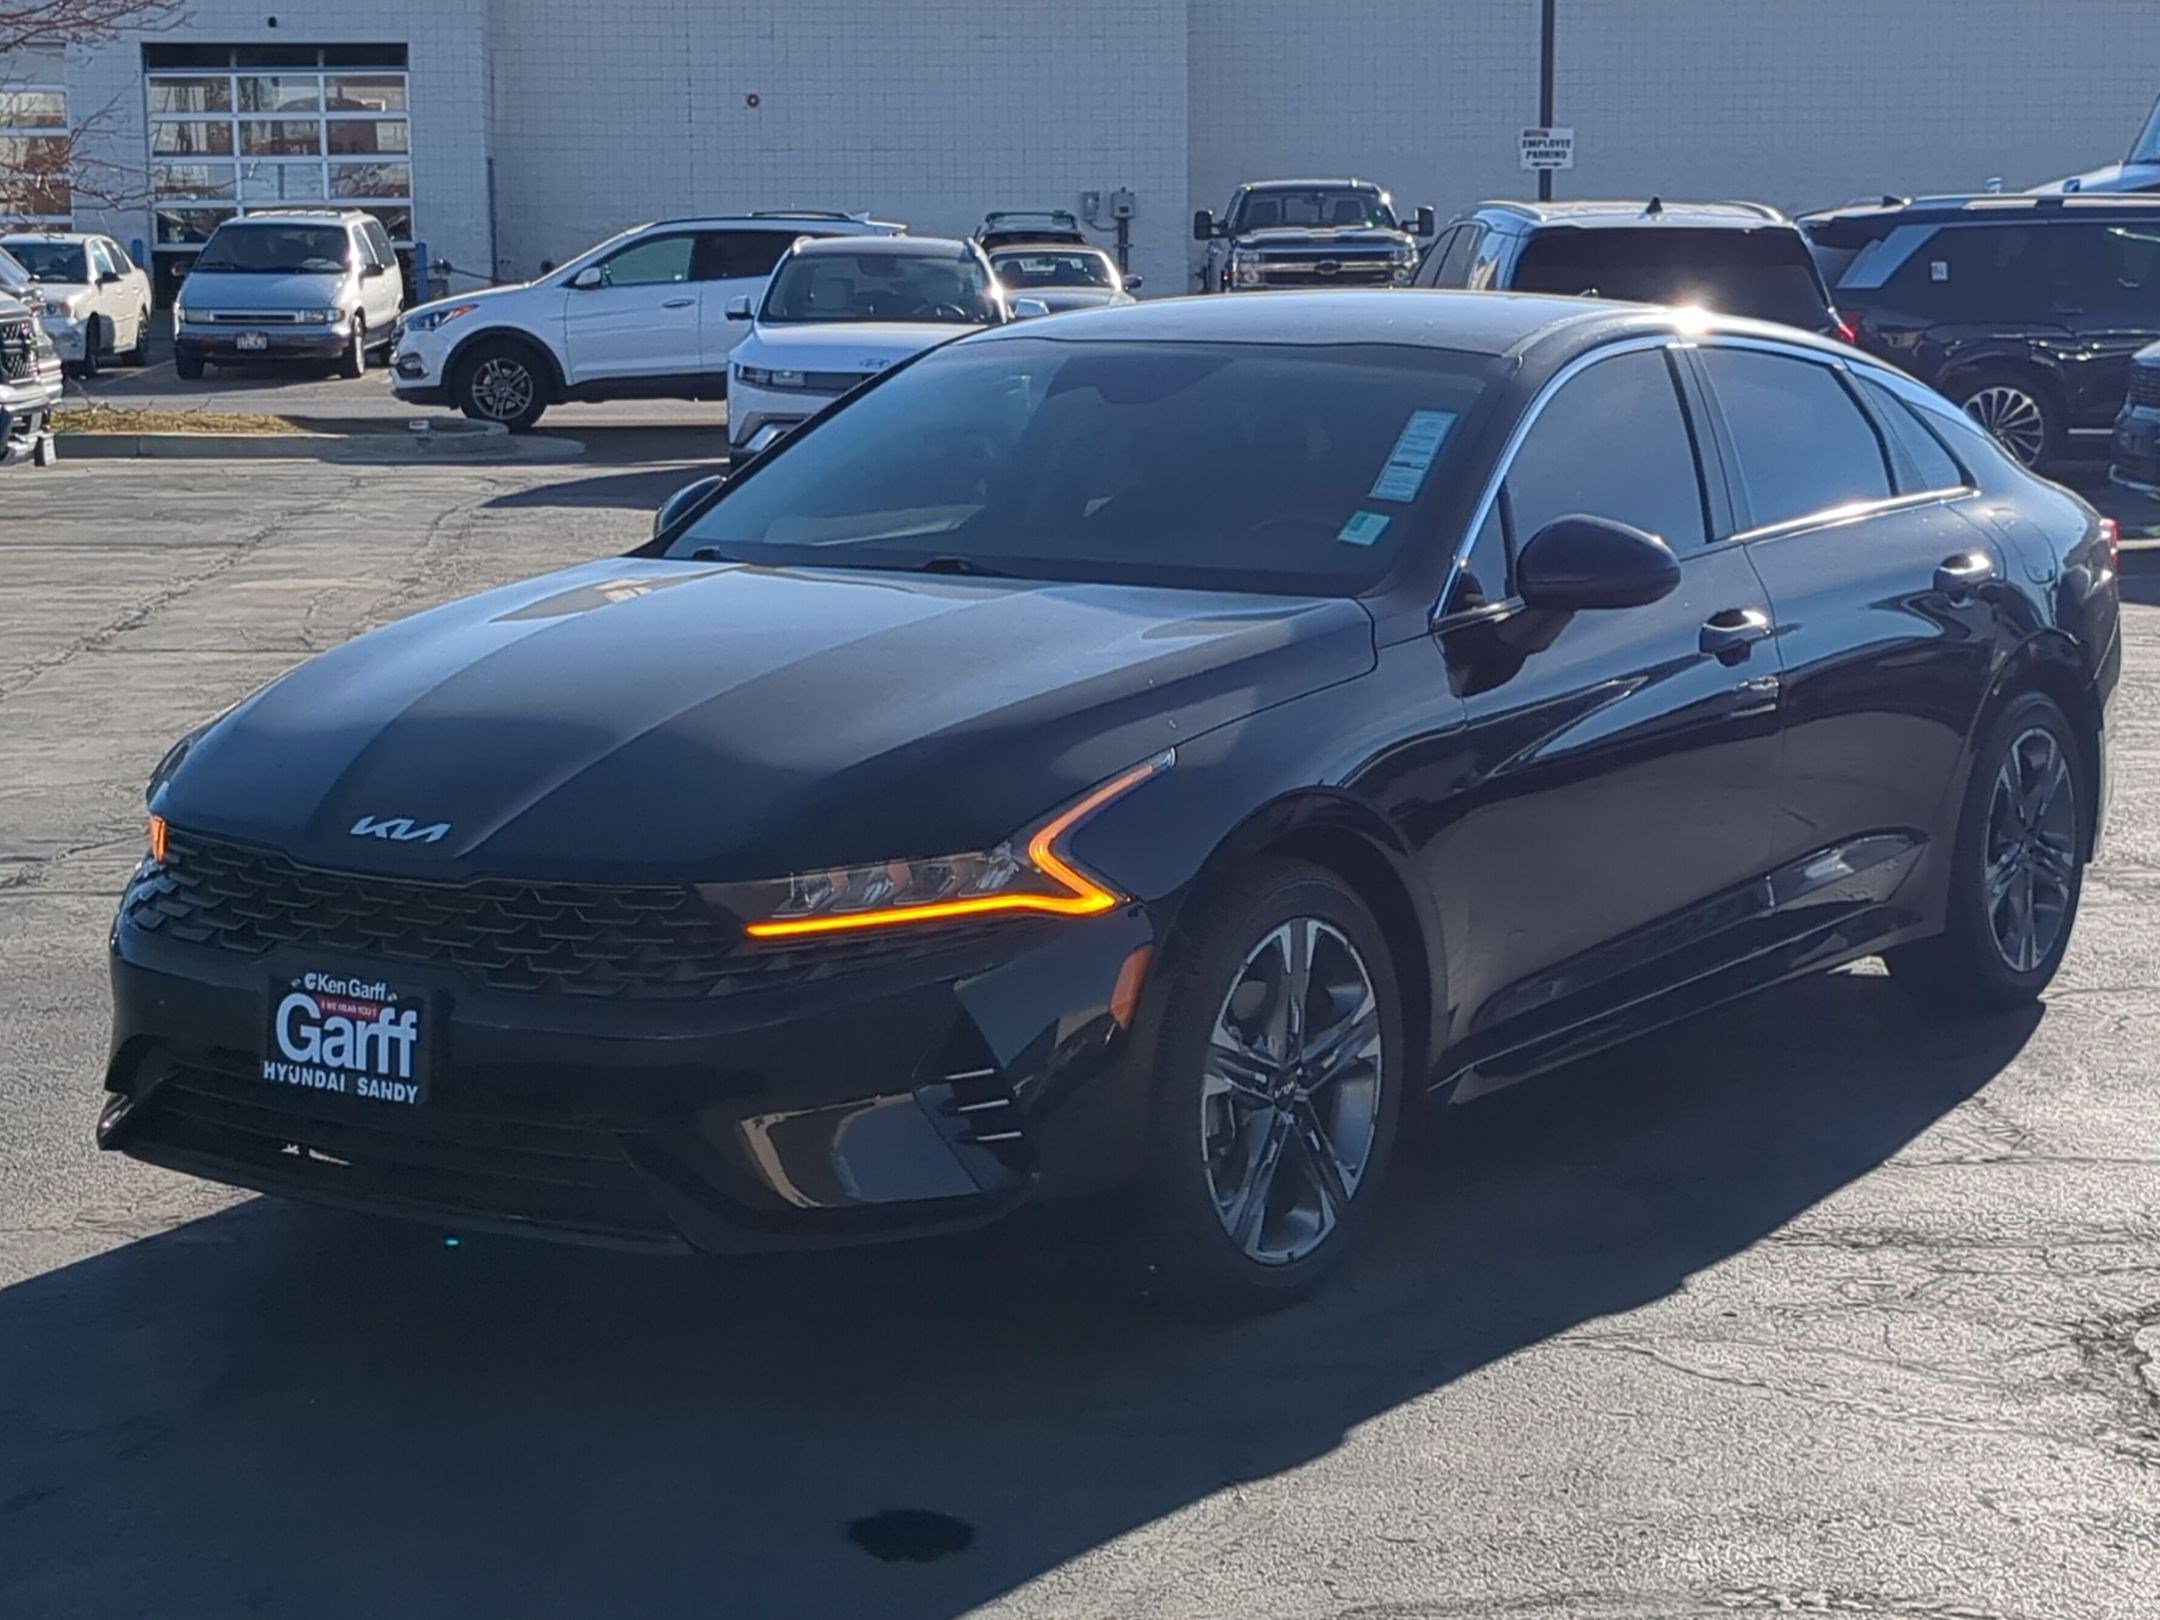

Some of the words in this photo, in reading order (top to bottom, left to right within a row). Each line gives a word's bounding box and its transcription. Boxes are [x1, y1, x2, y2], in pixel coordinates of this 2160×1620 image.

[1522, 139, 1571, 149] EMPLOYEE
[1526, 150, 1567, 160] PARKING
[317, 973, 346, 995] Ken
[349, 978, 386, 1001] Garff
[276, 992, 417, 1078] Garff
[263, 1060, 345, 1092] HYUNDAI
[357, 1076, 418, 1104] SANDY
